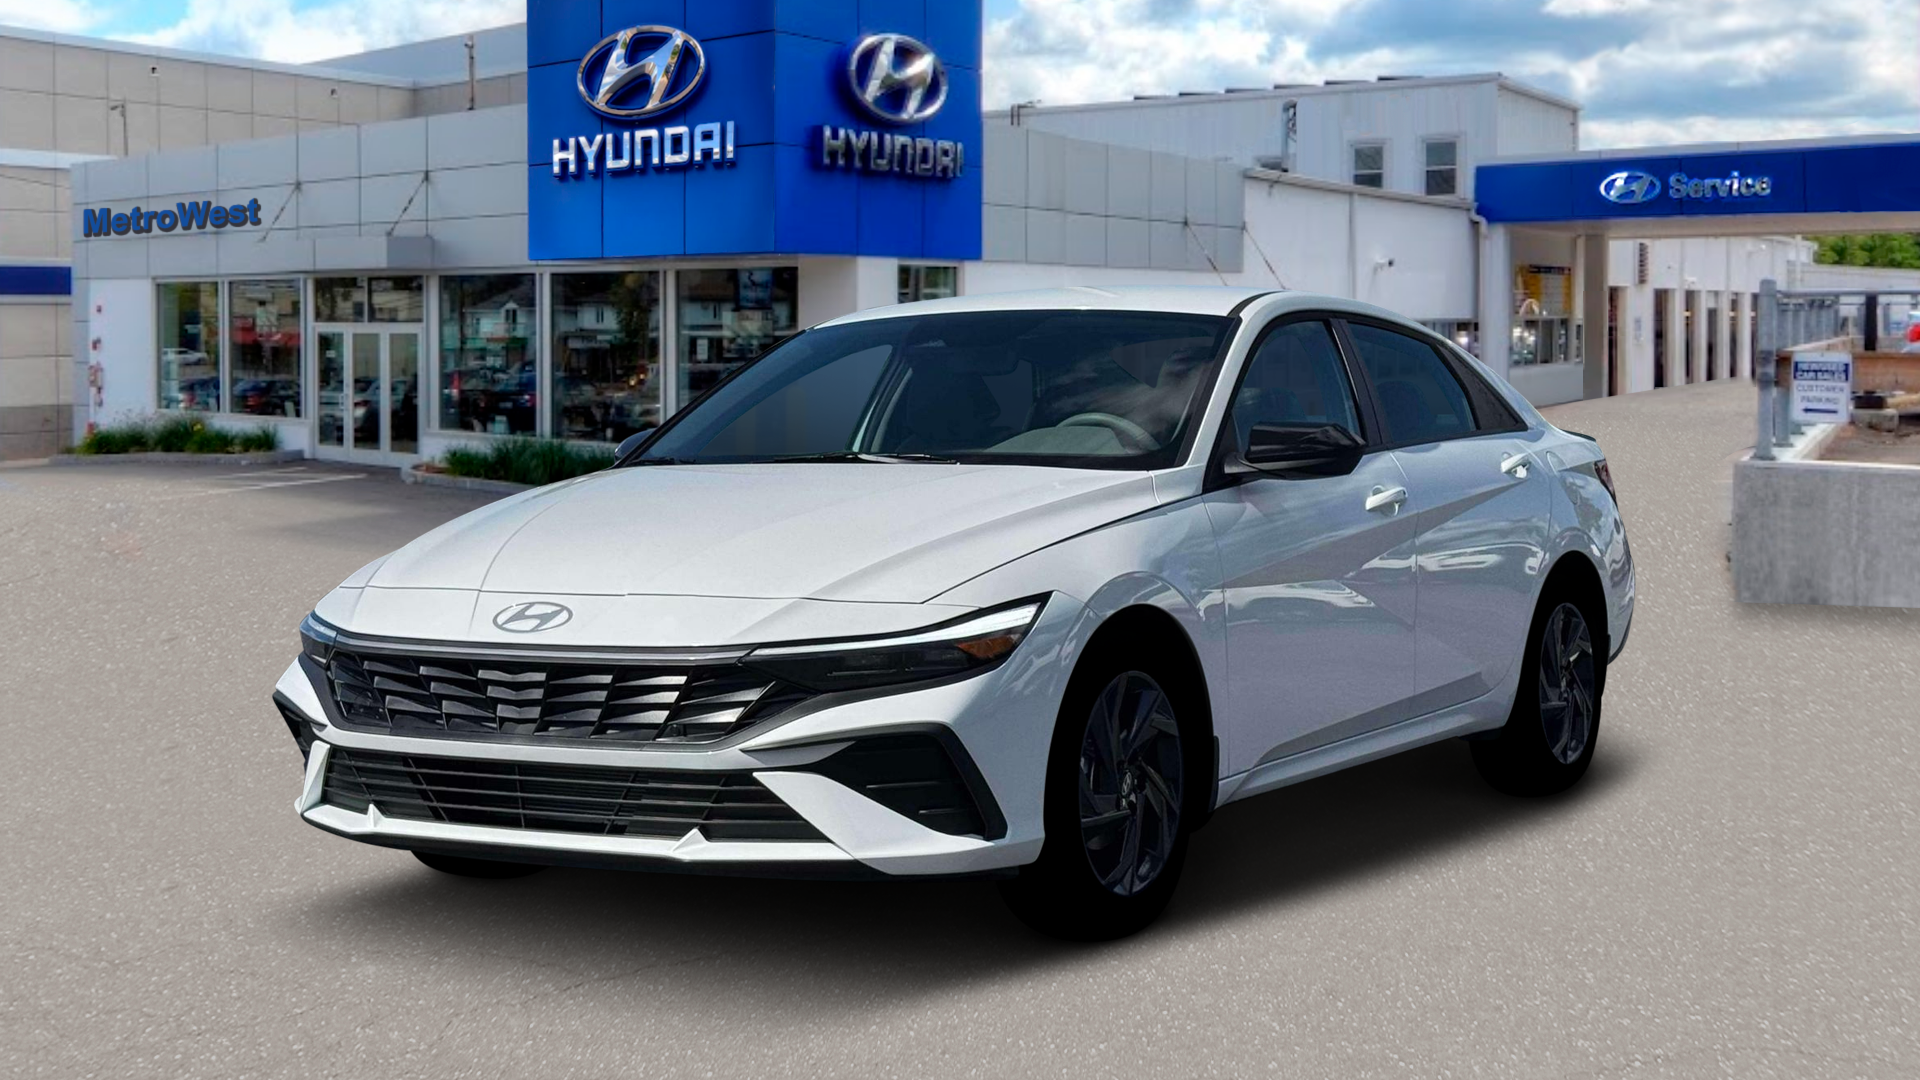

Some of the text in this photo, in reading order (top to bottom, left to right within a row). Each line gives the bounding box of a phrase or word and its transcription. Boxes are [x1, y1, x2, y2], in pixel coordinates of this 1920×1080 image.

[552, 120, 735, 175] HYUNDAI
[822, 124, 965, 179] HYUNDAI
[1668, 170, 1772, 199] Service
[83, 197, 262, 238] MetroWest
